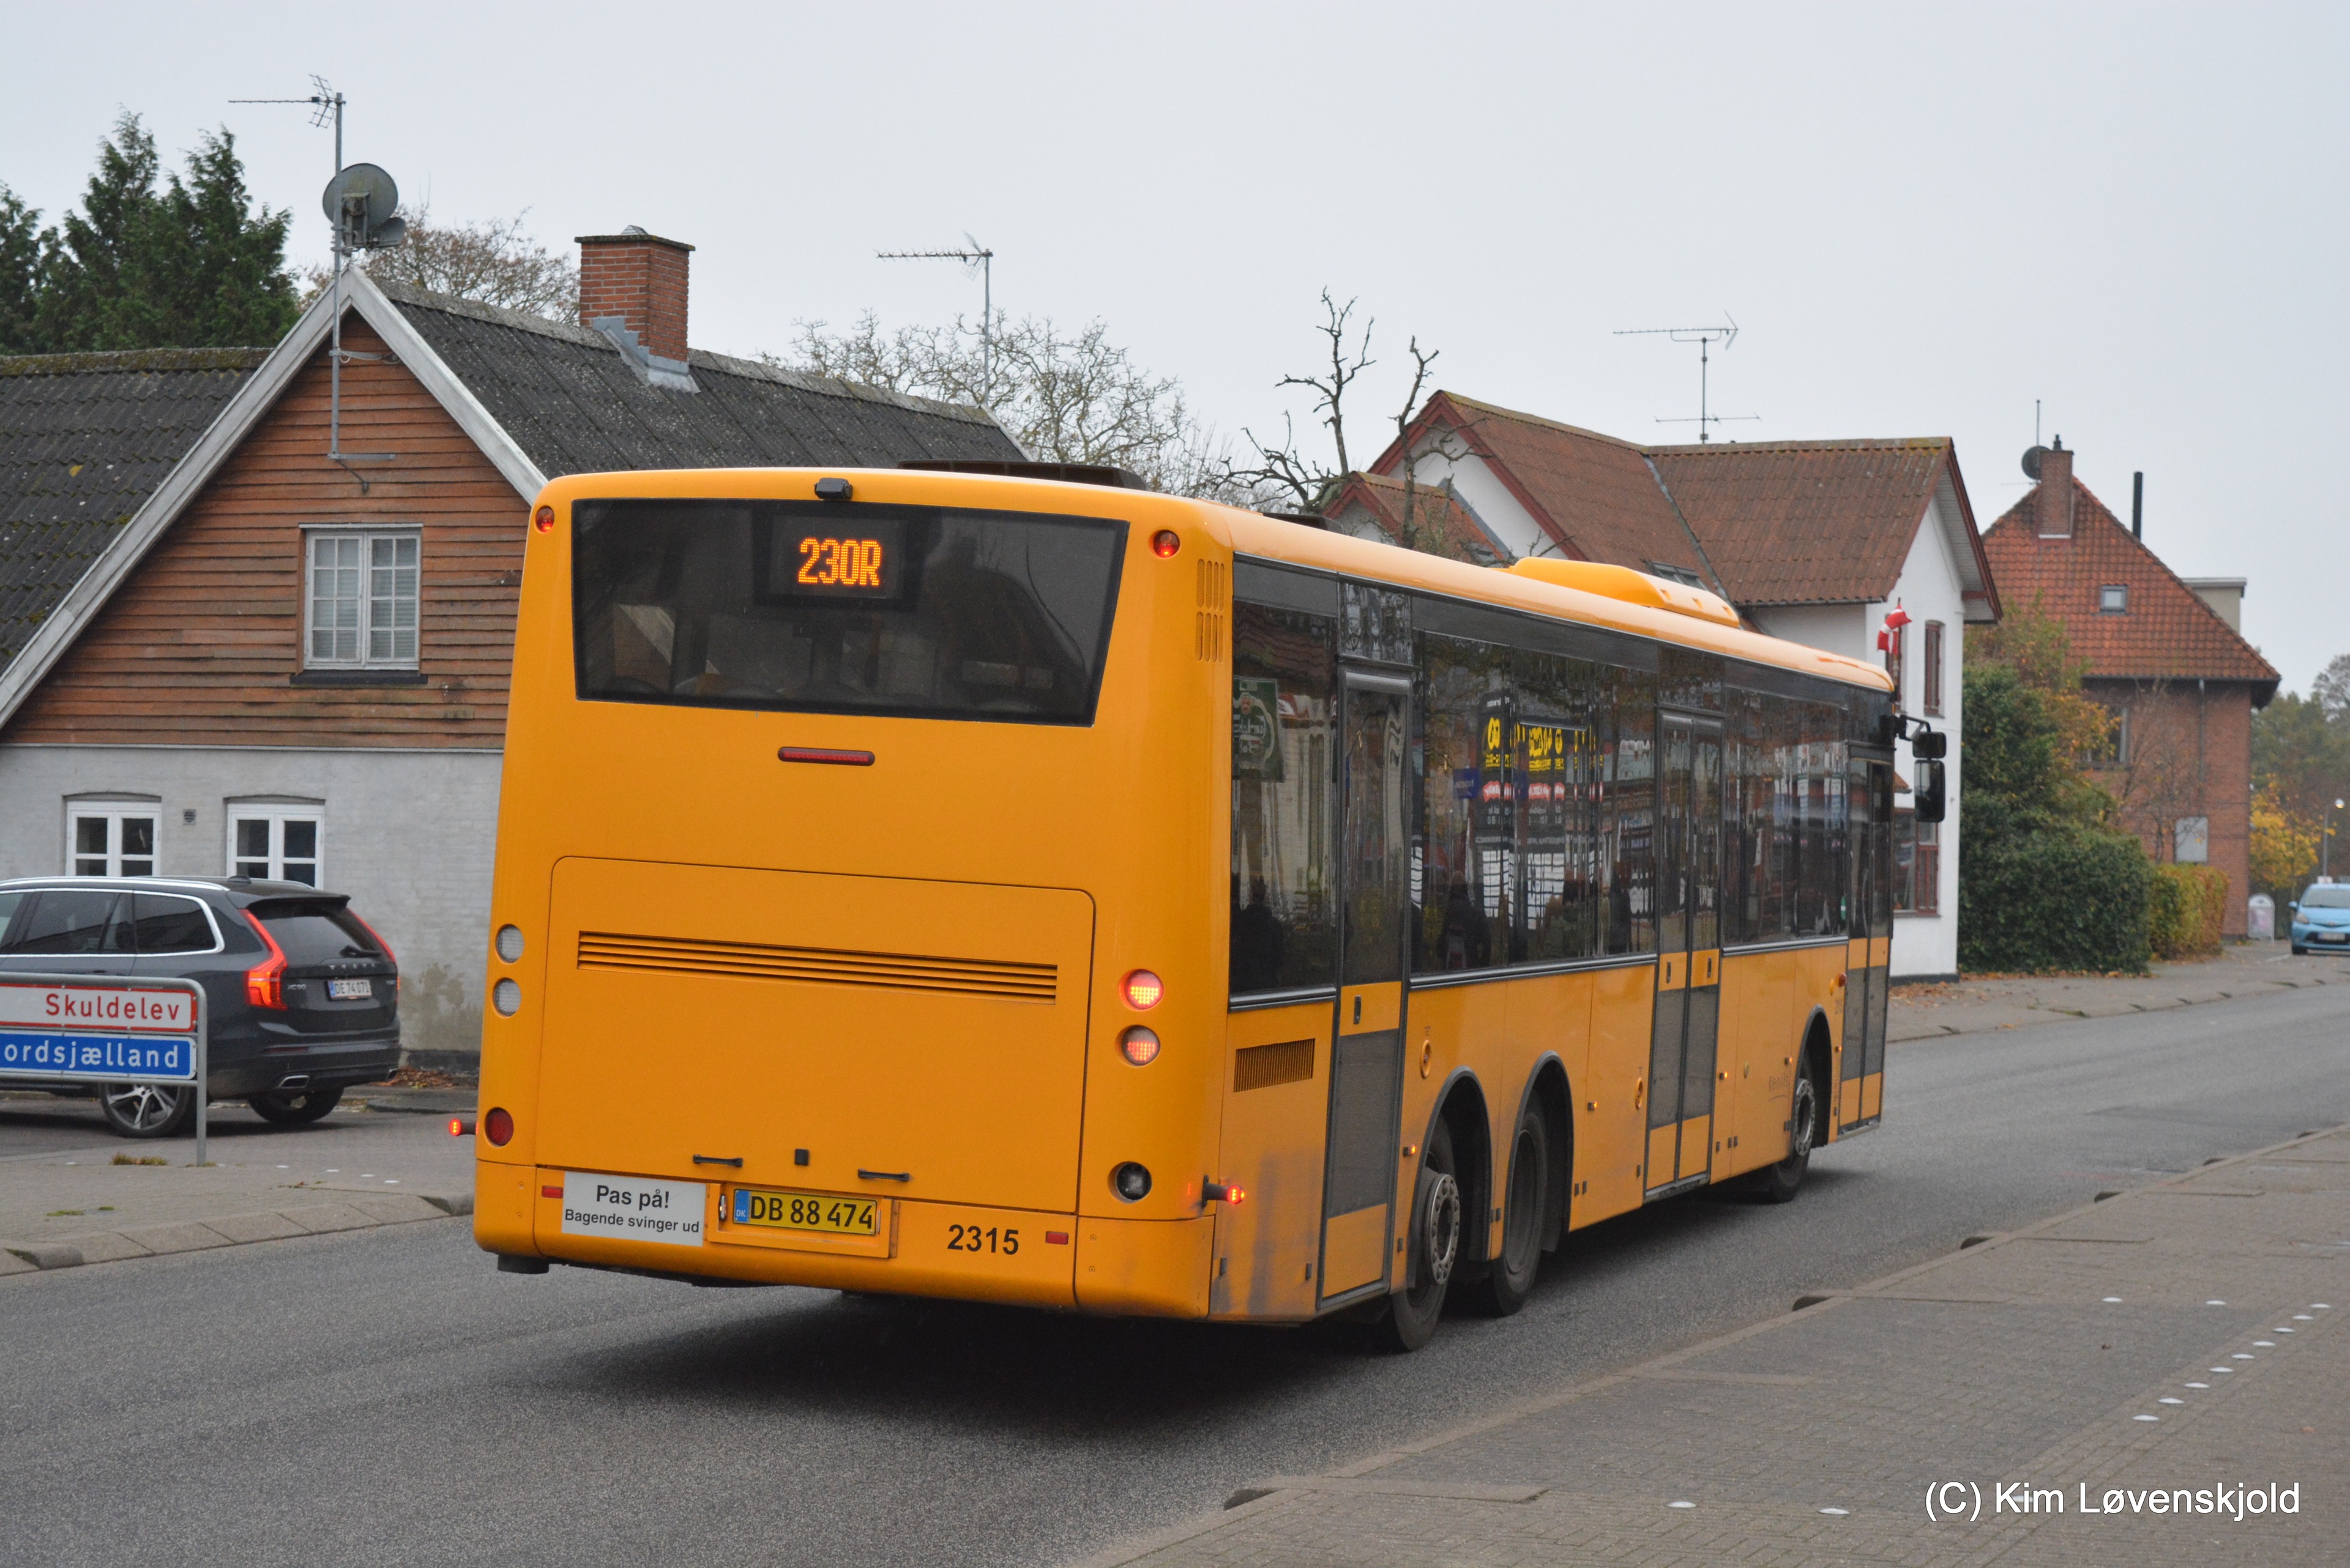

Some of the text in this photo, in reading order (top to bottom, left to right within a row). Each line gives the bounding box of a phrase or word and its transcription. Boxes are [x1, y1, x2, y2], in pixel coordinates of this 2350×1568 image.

[798, 538, 881, 586] 230R
[45, 993, 180, 1020] Skuldelev
[4, 1039, 179, 1069] ordsjælland
[596, 1184, 670, 1211] Pas på!
[565, 1208, 699, 1233] Bagende svinger ud
[736, 1209, 746, 1217] DK
[750, 1195, 873, 1229] DB 88 474
[947, 1224, 1019, 1255] 2315
